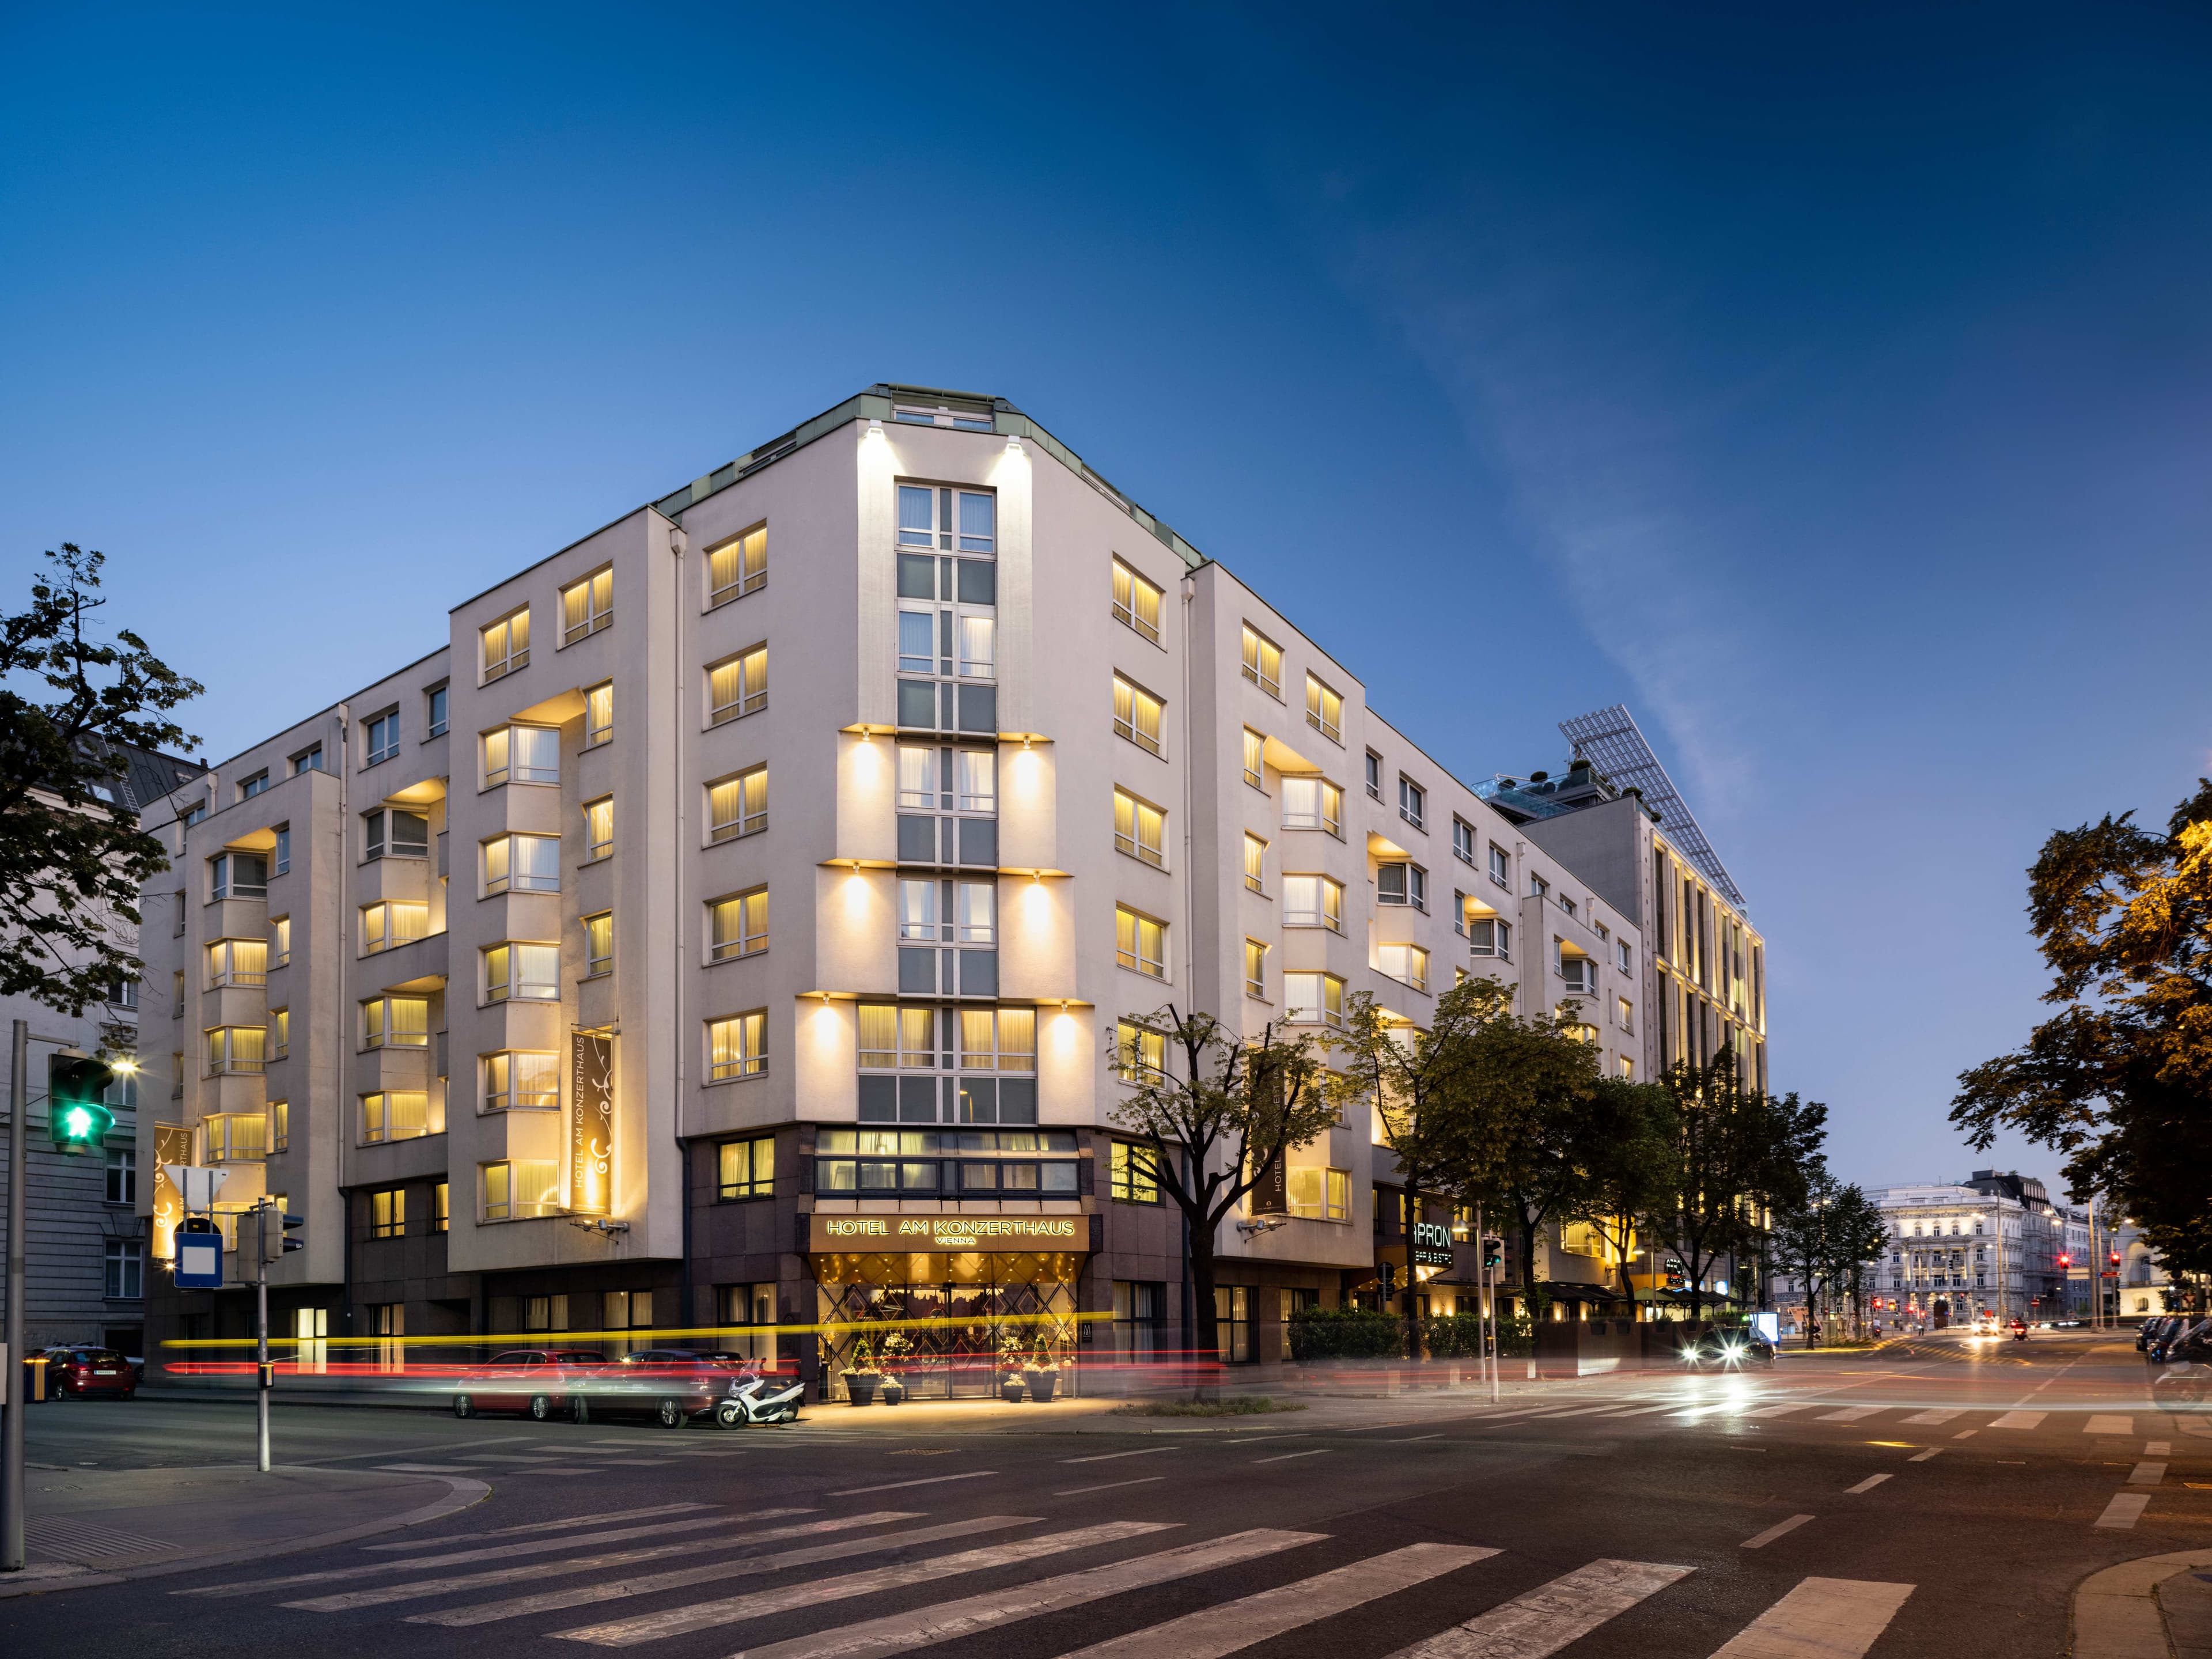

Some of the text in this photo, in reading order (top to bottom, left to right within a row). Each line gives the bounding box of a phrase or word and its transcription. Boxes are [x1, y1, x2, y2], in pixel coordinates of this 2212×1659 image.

[575, 1037, 585, 1188] HOTEL AM KONZERTHAUS
[828, 1221, 1074, 1235] HOTEL AM KONZERTHAUS
[1415, 1251, 1426, 1262] BAR
[1428, 1252, 1432, 1262] &
